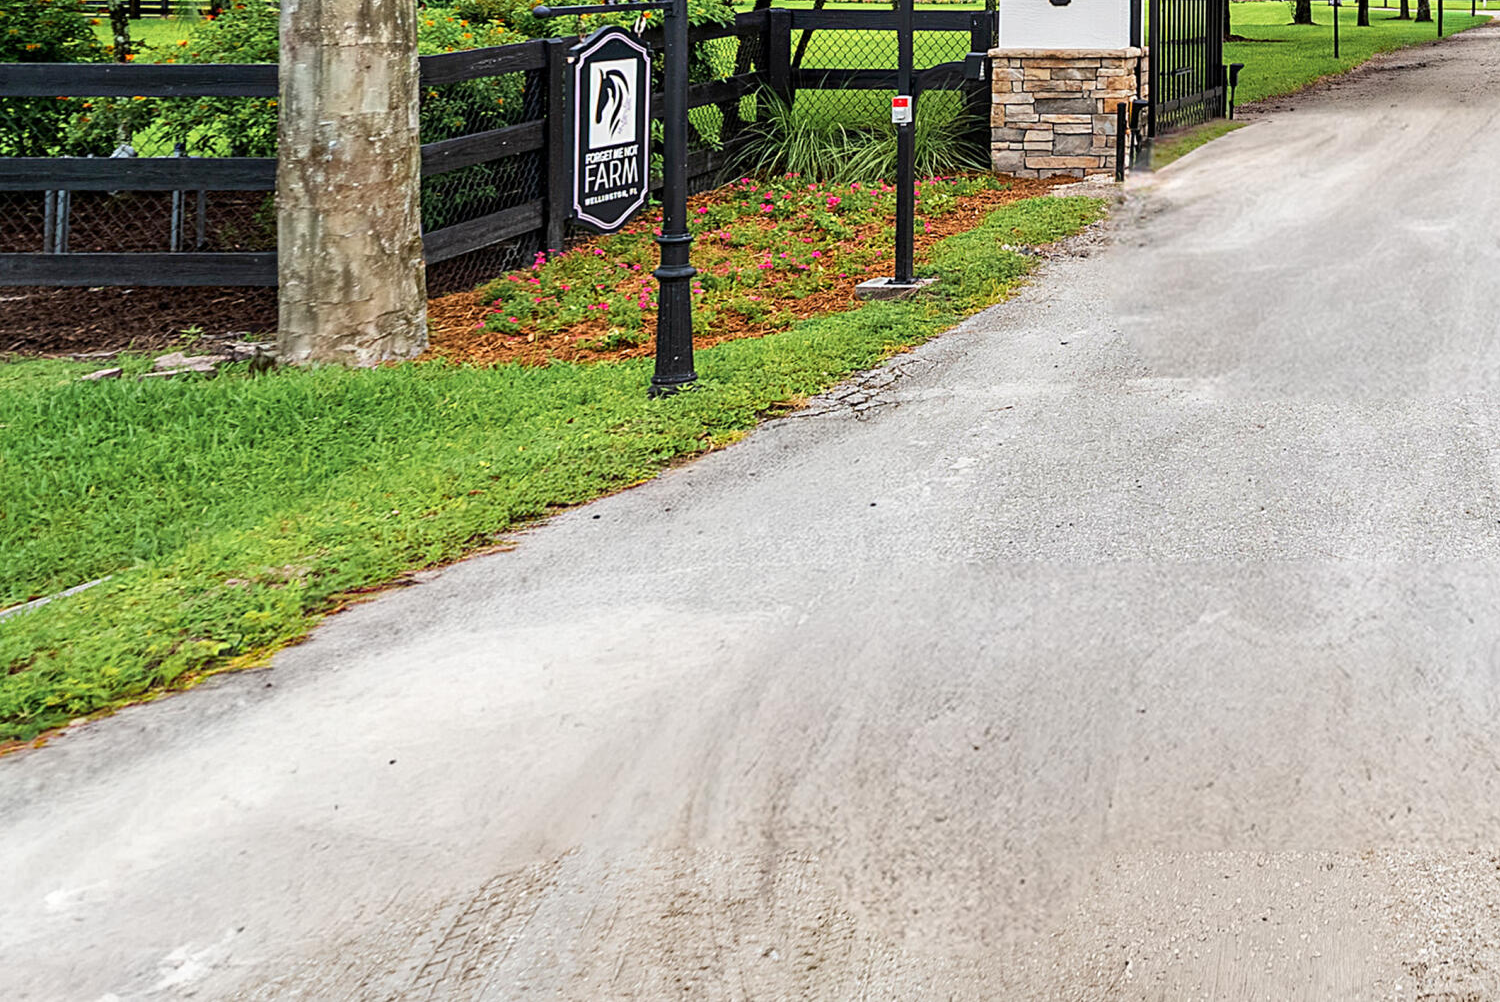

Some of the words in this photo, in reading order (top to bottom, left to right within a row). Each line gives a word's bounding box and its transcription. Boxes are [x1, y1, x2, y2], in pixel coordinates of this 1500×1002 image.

[585, 149, 613, 165] FORGET
[624, 144, 639, 157] NOT
[585, 156, 639, 193] FARM
